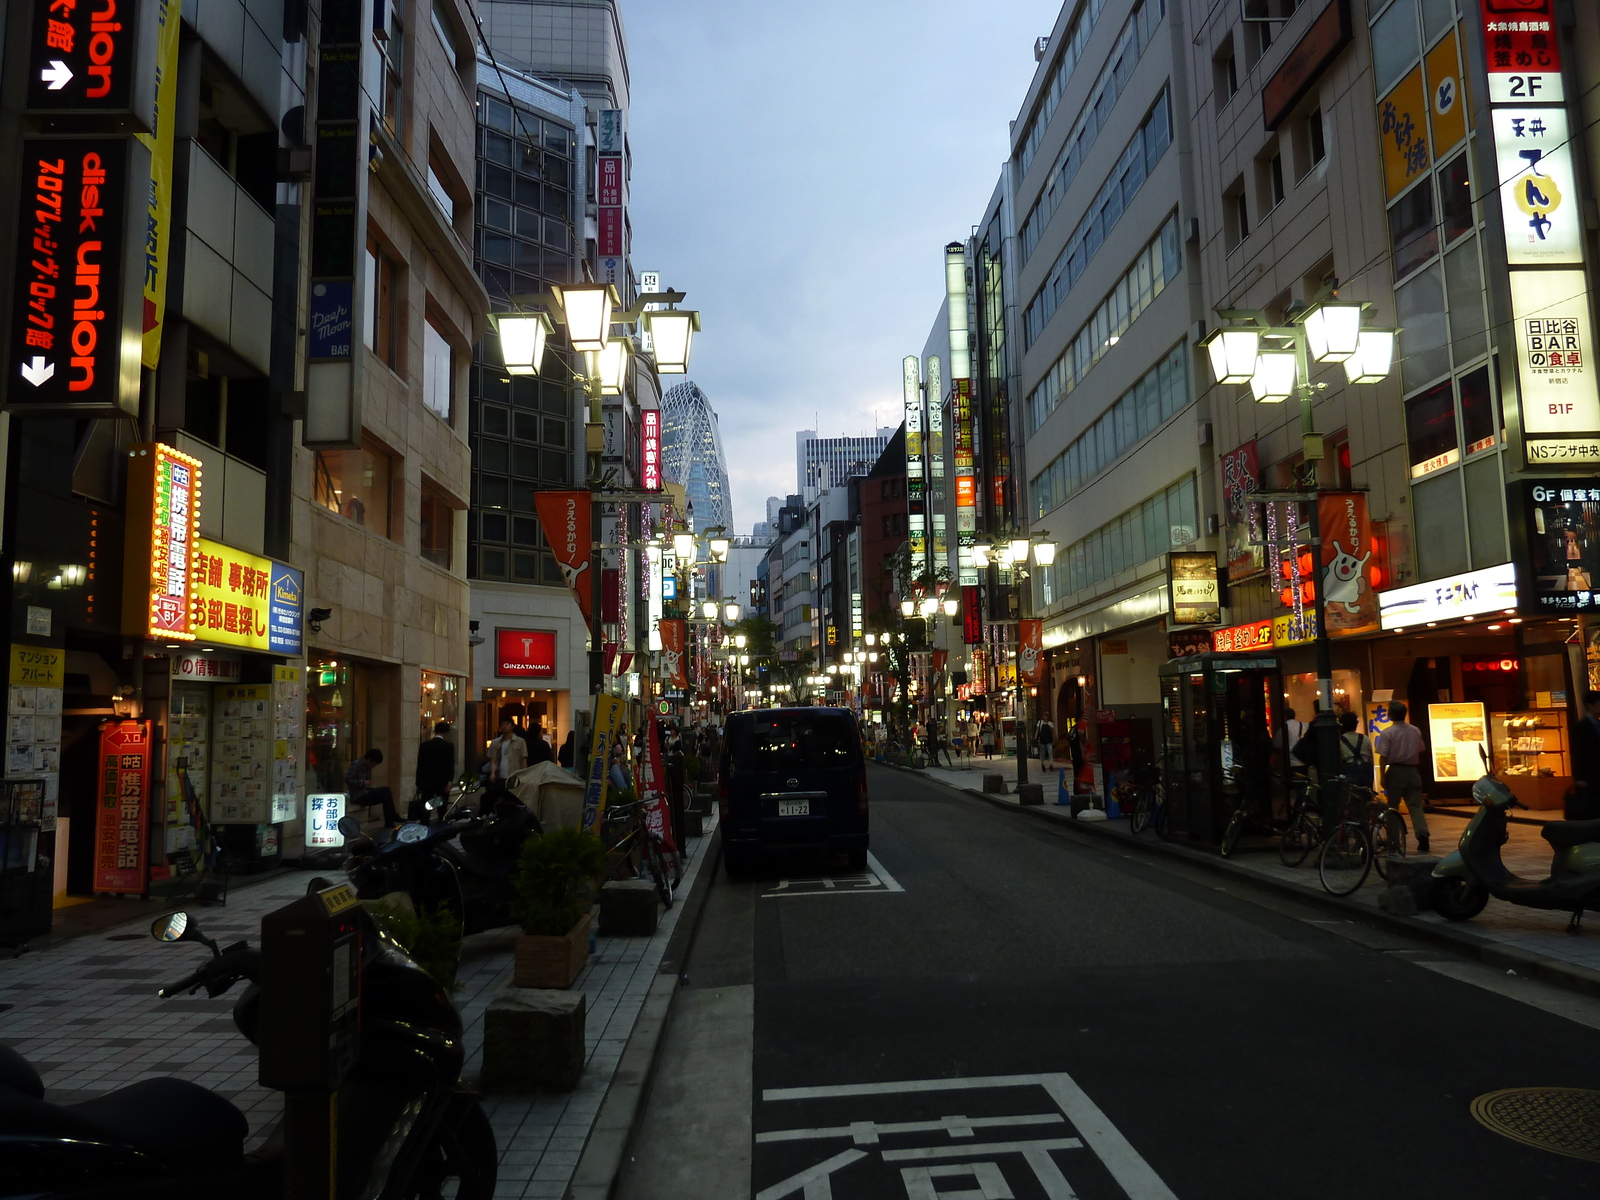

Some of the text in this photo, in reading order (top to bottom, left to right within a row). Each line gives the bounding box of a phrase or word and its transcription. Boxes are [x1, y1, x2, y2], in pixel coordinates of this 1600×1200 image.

[1487, 21, 1550, 32] 大衆焼鳥酒場
[323, 53, 338, 61] Music
[1493, 51, 1552, 67] 釜めし
[1508, 76, 1542, 97] 2F
[1439, 83, 1452, 110] と
[320, 128, 356, 137] Music School
[1511, 117, 1547, 138] 天丼
[604, 160, 616, 187] 品川
[1518, 149, 1552, 243] てんや
[317, 206, 353, 217] Music School
[69, 152, 105, 391] disk union
[312, 305, 347, 329] Deep
[318, 320, 351, 341] Moon
[1528, 319, 1577, 335] 日比谷
[330, 345, 350, 357] BAR
[1530, 336, 1578, 351] BAR
[1531, 351, 1580, 367] の食卓
[1548, 403, 1574, 415] B1F
[646, 412, 657, 490] 品川美容外科
[1532, 486, 1556, 502] 6F
[228, 562, 269, 600] 事務所
[164, 612, 175, 622] B1
[194, 597, 267, 637] お部屋探し
[1258, 627, 1270, 643] 2F
[1276, 623, 1286, 640] 3F
[19, 650, 59, 666] マンション
[21, 668, 54, 683] アパート
[123, 733, 142, 743] 入口
[122, 757, 142, 770] 中古
[104, 755, 119, 810] 高価買取
[118, 772, 142, 869] 携帯電話
[311, 797, 325, 831] 探し
[325, 798, 338, 831] お部屋
[101, 813, 117, 869] 激安販売
